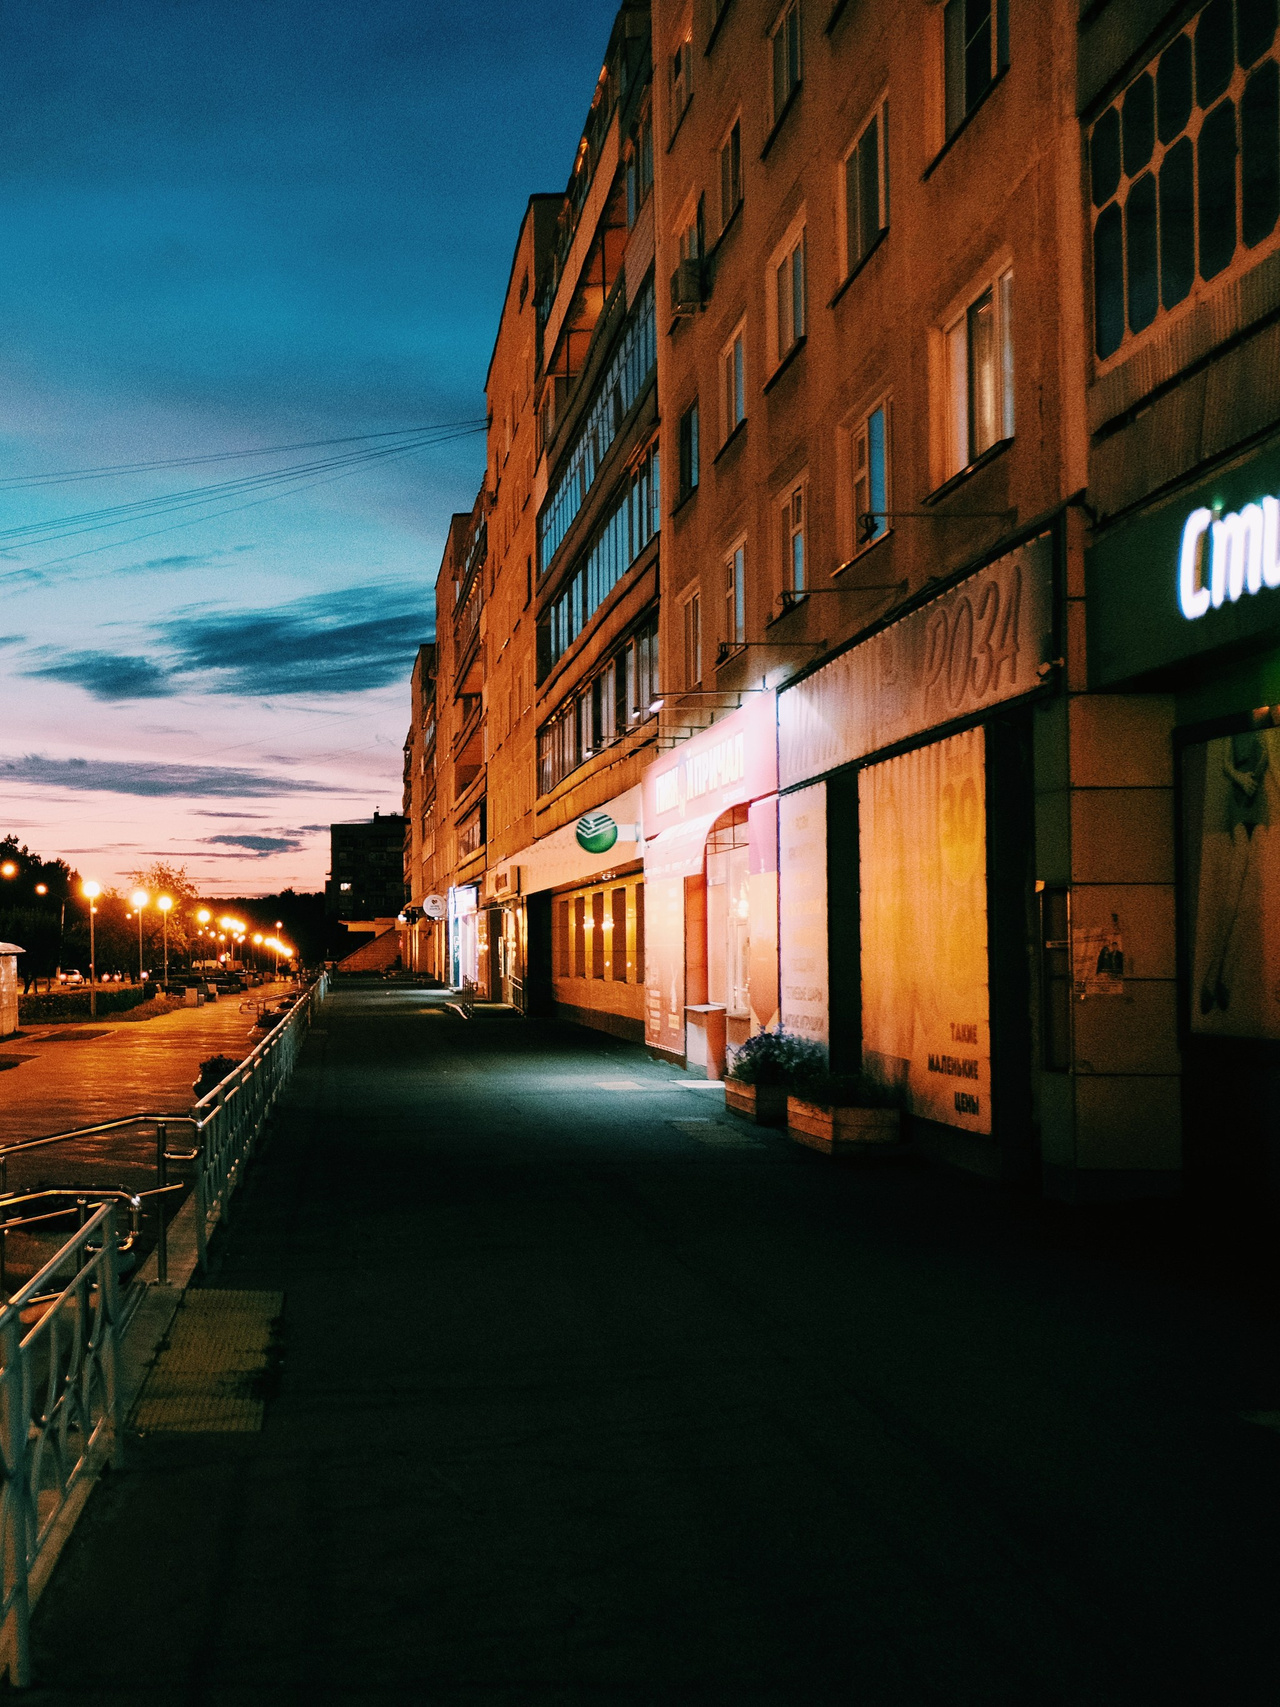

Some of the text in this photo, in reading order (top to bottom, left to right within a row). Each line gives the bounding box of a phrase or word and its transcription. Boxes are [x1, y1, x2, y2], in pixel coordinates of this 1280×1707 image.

[922, 564, 1023, 720] РОЗА
[950, 1022, 978, 1045] ТАКИЕ
[928, 1053, 979, 1080] МАЛЕНЬКИЕ
[954, 1091, 980, 1116] ЦЕНЫ
